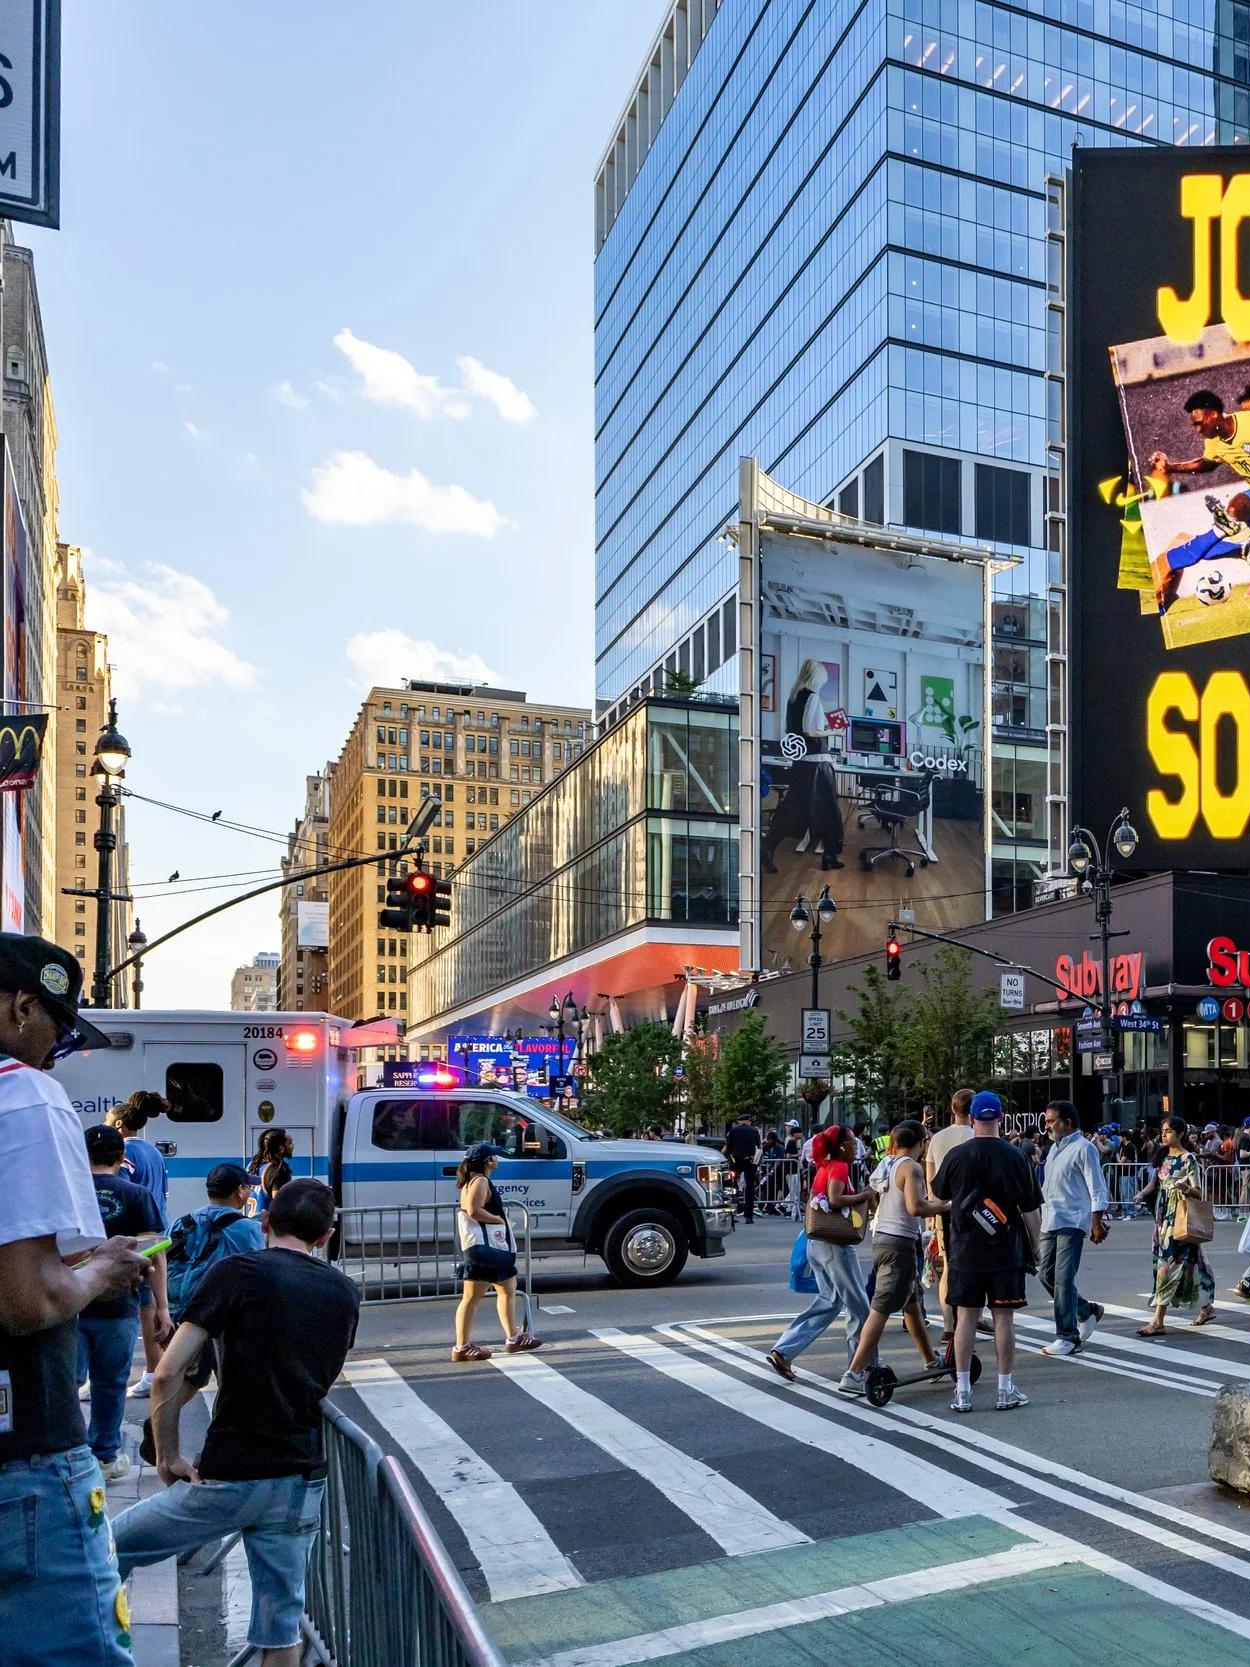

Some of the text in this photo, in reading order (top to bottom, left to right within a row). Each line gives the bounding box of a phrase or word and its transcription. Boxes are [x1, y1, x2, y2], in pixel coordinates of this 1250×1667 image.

[909, 751, 968, 772] Codex
[1056, 950, 1143, 1000] Subway
[1006, 978, 1019, 987] NO
[1002, 989, 1023, 997] TURNS
[1200, 1003, 1217, 1016] MTA
[1077, 1020, 1101, 1030] Seventh Ave
[1120, 1019, 1159, 1029] West 34th St
[243, 1027, 283, 1038] 20184
[806, 1027, 826, 1039] 25
[454, 1043, 503, 1053] AERICA
[982, 1208, 998, 1224] KITH
